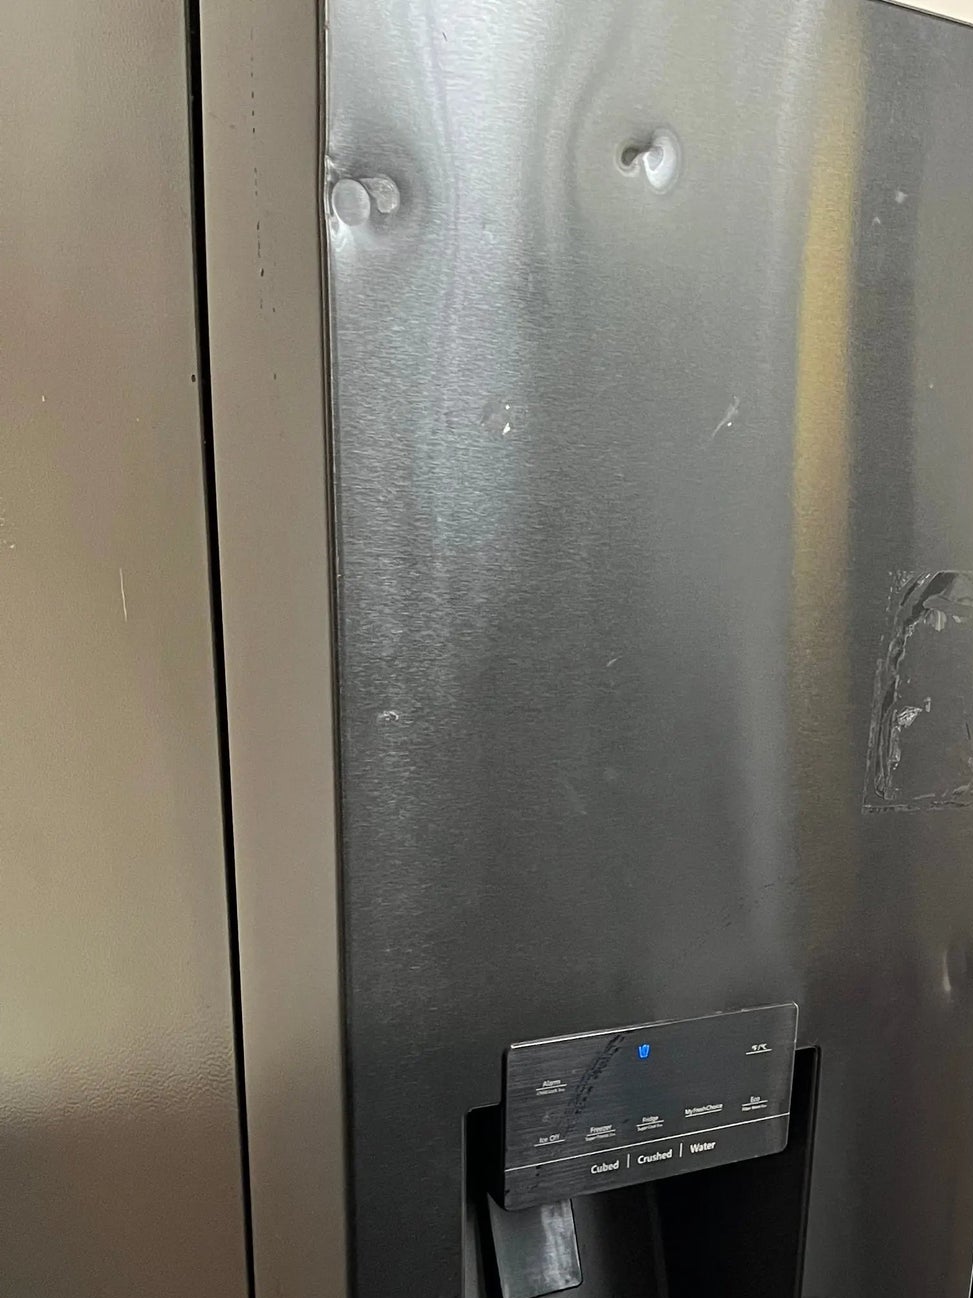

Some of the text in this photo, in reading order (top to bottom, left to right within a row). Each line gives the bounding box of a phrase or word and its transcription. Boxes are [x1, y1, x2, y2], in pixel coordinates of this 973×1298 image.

[542, 1079, 561, 1087] Alarm
[591, 1142, 716, 1174] Cubed Crushed Water
